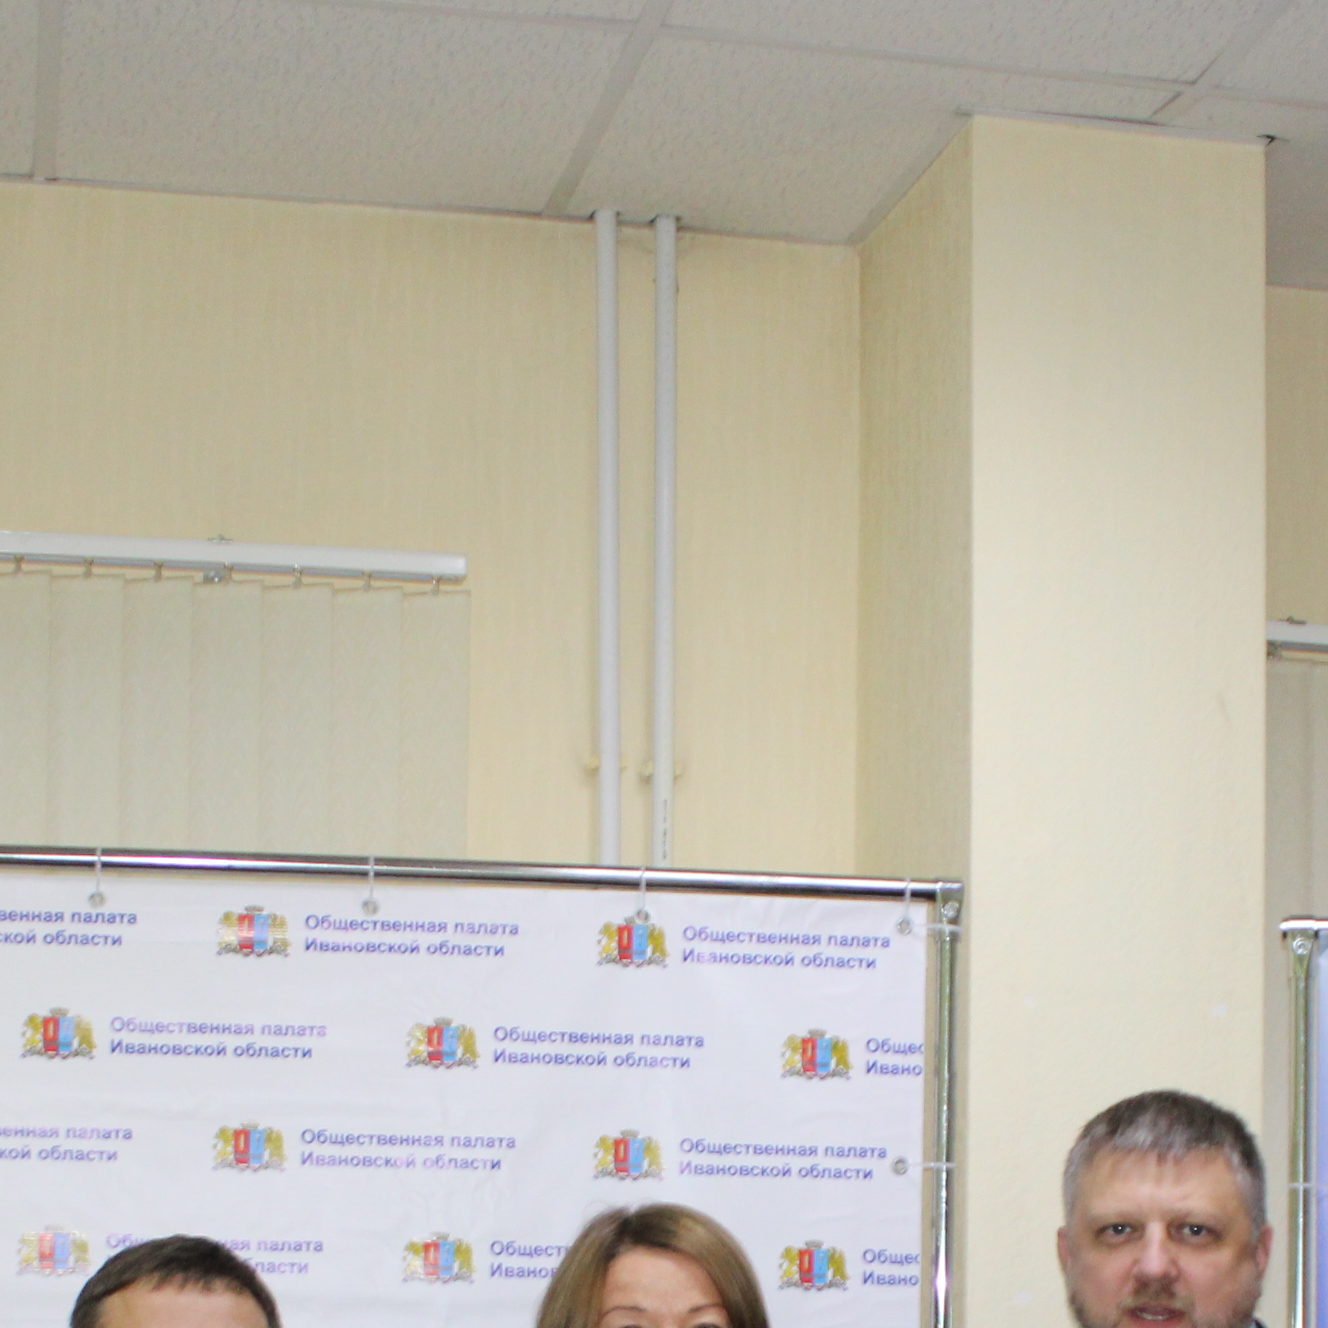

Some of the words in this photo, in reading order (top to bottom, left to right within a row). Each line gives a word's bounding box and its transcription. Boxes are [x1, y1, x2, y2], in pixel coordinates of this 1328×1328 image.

[70, 911, 137, 925] палата
[304, 914, 448, 933] Общественная
[453, 922, 520, 936] палата
[42, 929, 123, 946] области
[305, 937, 421, 954] Ивановской
[426, 940, 505, 956] области
[683, 926, 822, 946] Общественная
[827, 935, 891, 949] палата
[682, 949, 795, 966] Ивановской
[801, 953, 877, 969] области
[109, 1016, 256, 1035] Общественная
[260, 1024, 327, 1037] палата
[493, 1026, 634, 1045] Общественная
[640, 1034, 705, 1048] палата
[109, 1039, 227, 1057] Ивановской
[232, 1043, 313, 1059] области
[493, 1049, 607, 1066] Ивановской
[613, 1052, 692, 1068] области
[65, 1127, 133, 1141] палата
[300, 1129, 445, 1147] Общественная
[450, 1136, 517, 1149] палата
[37, 1145, 118, 1162] области
[680, 1138, 819, 1157] Общественная
[824, 1146, 888, 1159] палата
[300, 1151, 418, 1168] Ивановской
[423, 1153, 502, 1170] области
[679, 1161, 793, 1177] Ивановской
[798, 1164, 874, 1180] области
[256, 1240, 324, 1253] палата
